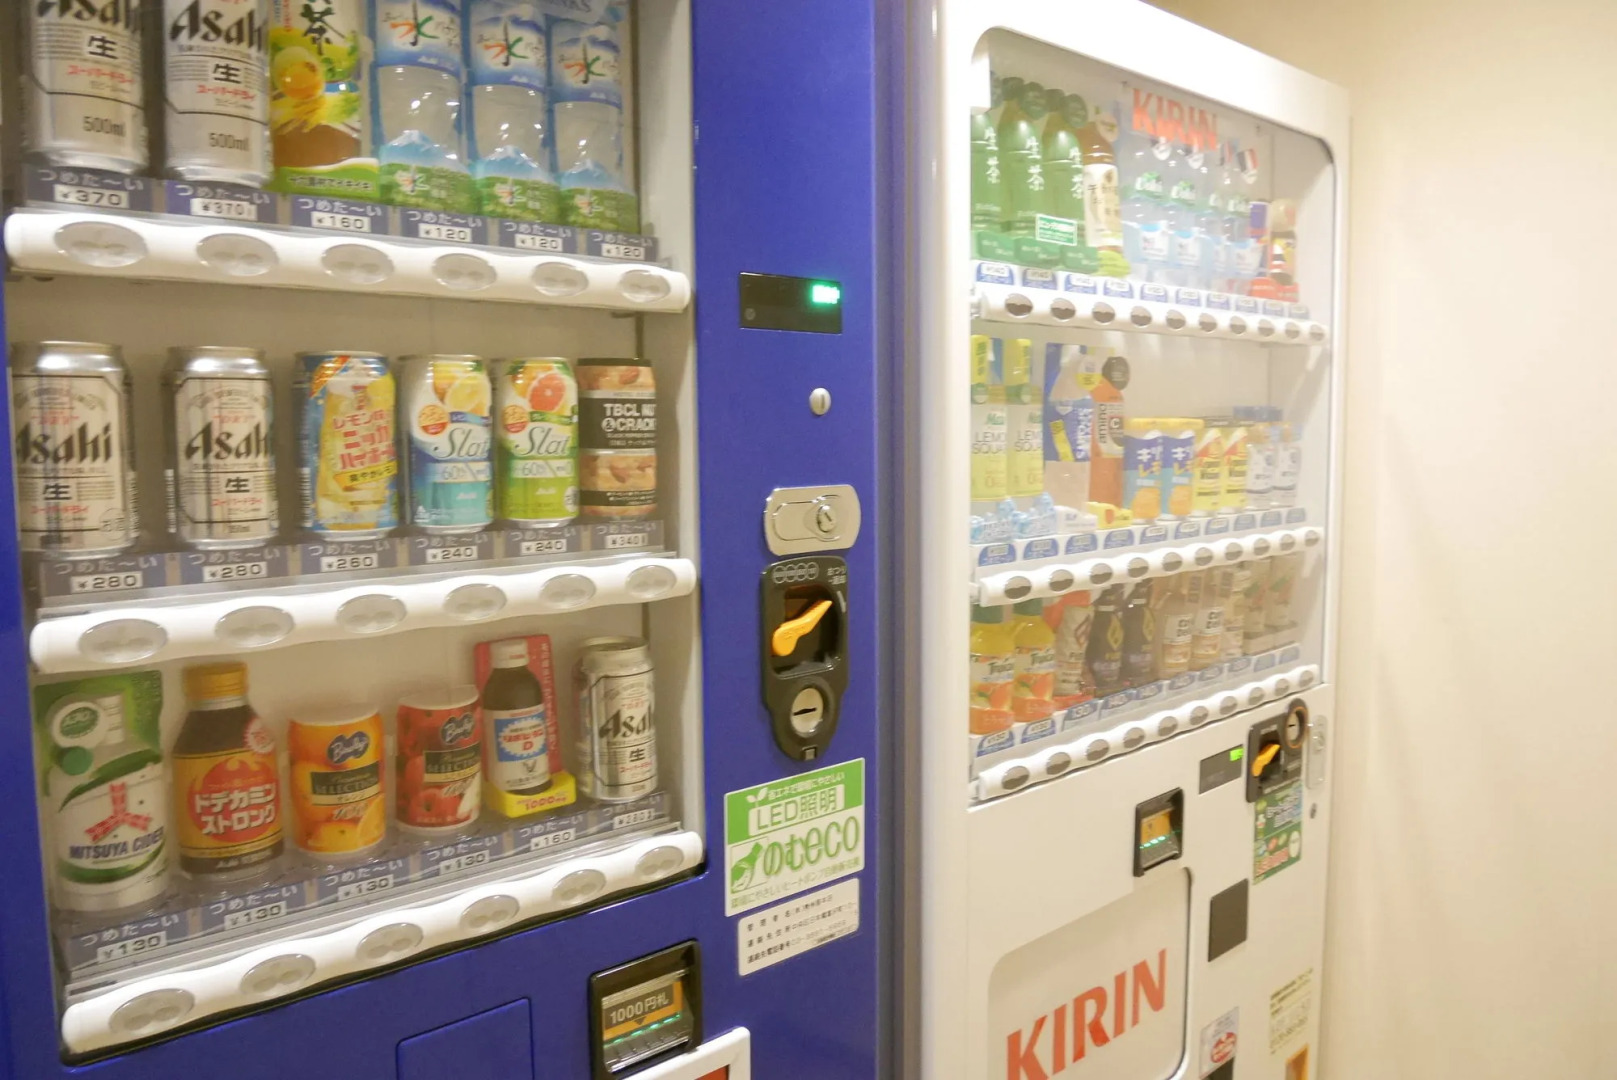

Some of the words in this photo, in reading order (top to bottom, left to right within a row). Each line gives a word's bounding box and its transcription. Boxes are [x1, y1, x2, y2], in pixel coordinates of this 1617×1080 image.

[87, 35, 119, 61] 生
[212, 63, 242, 85] 生
[1131, 87, 1219, 150] KIRIN
[603, 403, 640, 417] TBCL
[43, 482, 73, 501] 生
[225, 476, 251, 494] 生
[522, 740, 534, 752] D
[628, 747, 645, 763] 生
[194, 782, 277, 815] ドデカミン
[757, 787, 837, 831] LED照明
[199, 803, 276, 835] ストロング
[68, 840, 128, 860] MITSUYA
[763, 815, 860, 877] のむeco
[610, 991, 670, 1025] 1000円札
[1006, 949, 1167, 1080] KIRIN
